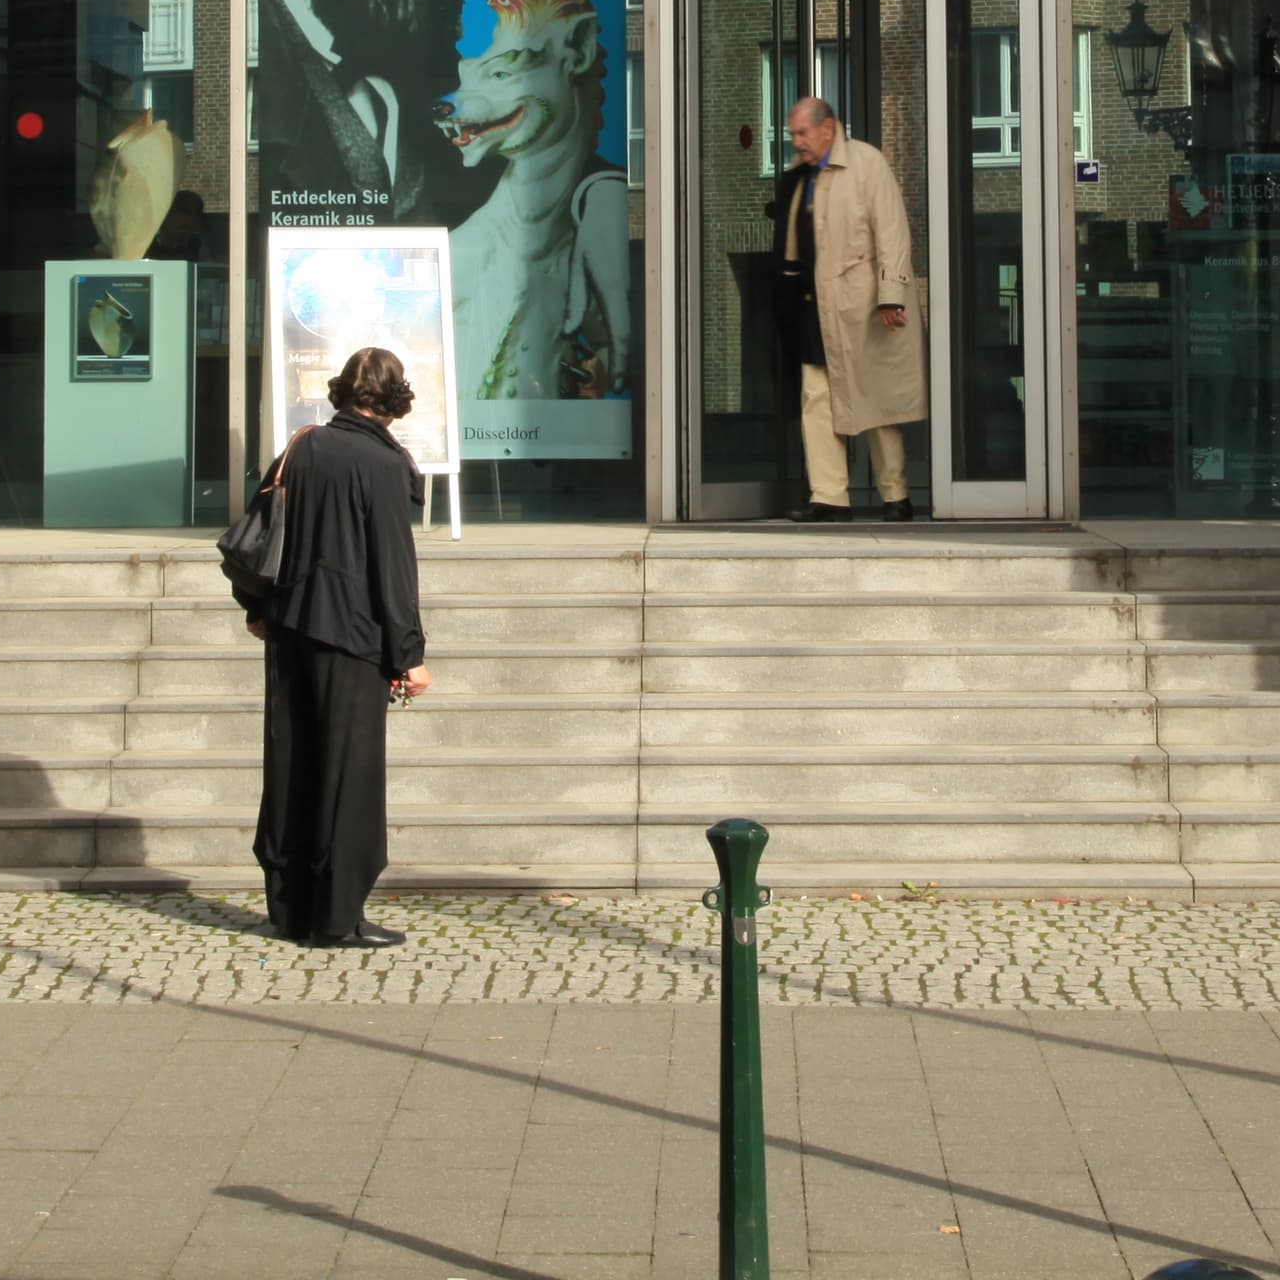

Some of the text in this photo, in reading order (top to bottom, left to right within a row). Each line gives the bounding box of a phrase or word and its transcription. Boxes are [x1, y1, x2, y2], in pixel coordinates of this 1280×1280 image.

[271, 190, 389, 205] Entdecken Sie
[271, 211, 375, 226] Keramik aus
[1204, 255, 1247, 266] Keramik
[464, 425, 542, 441] Düsseldorf
